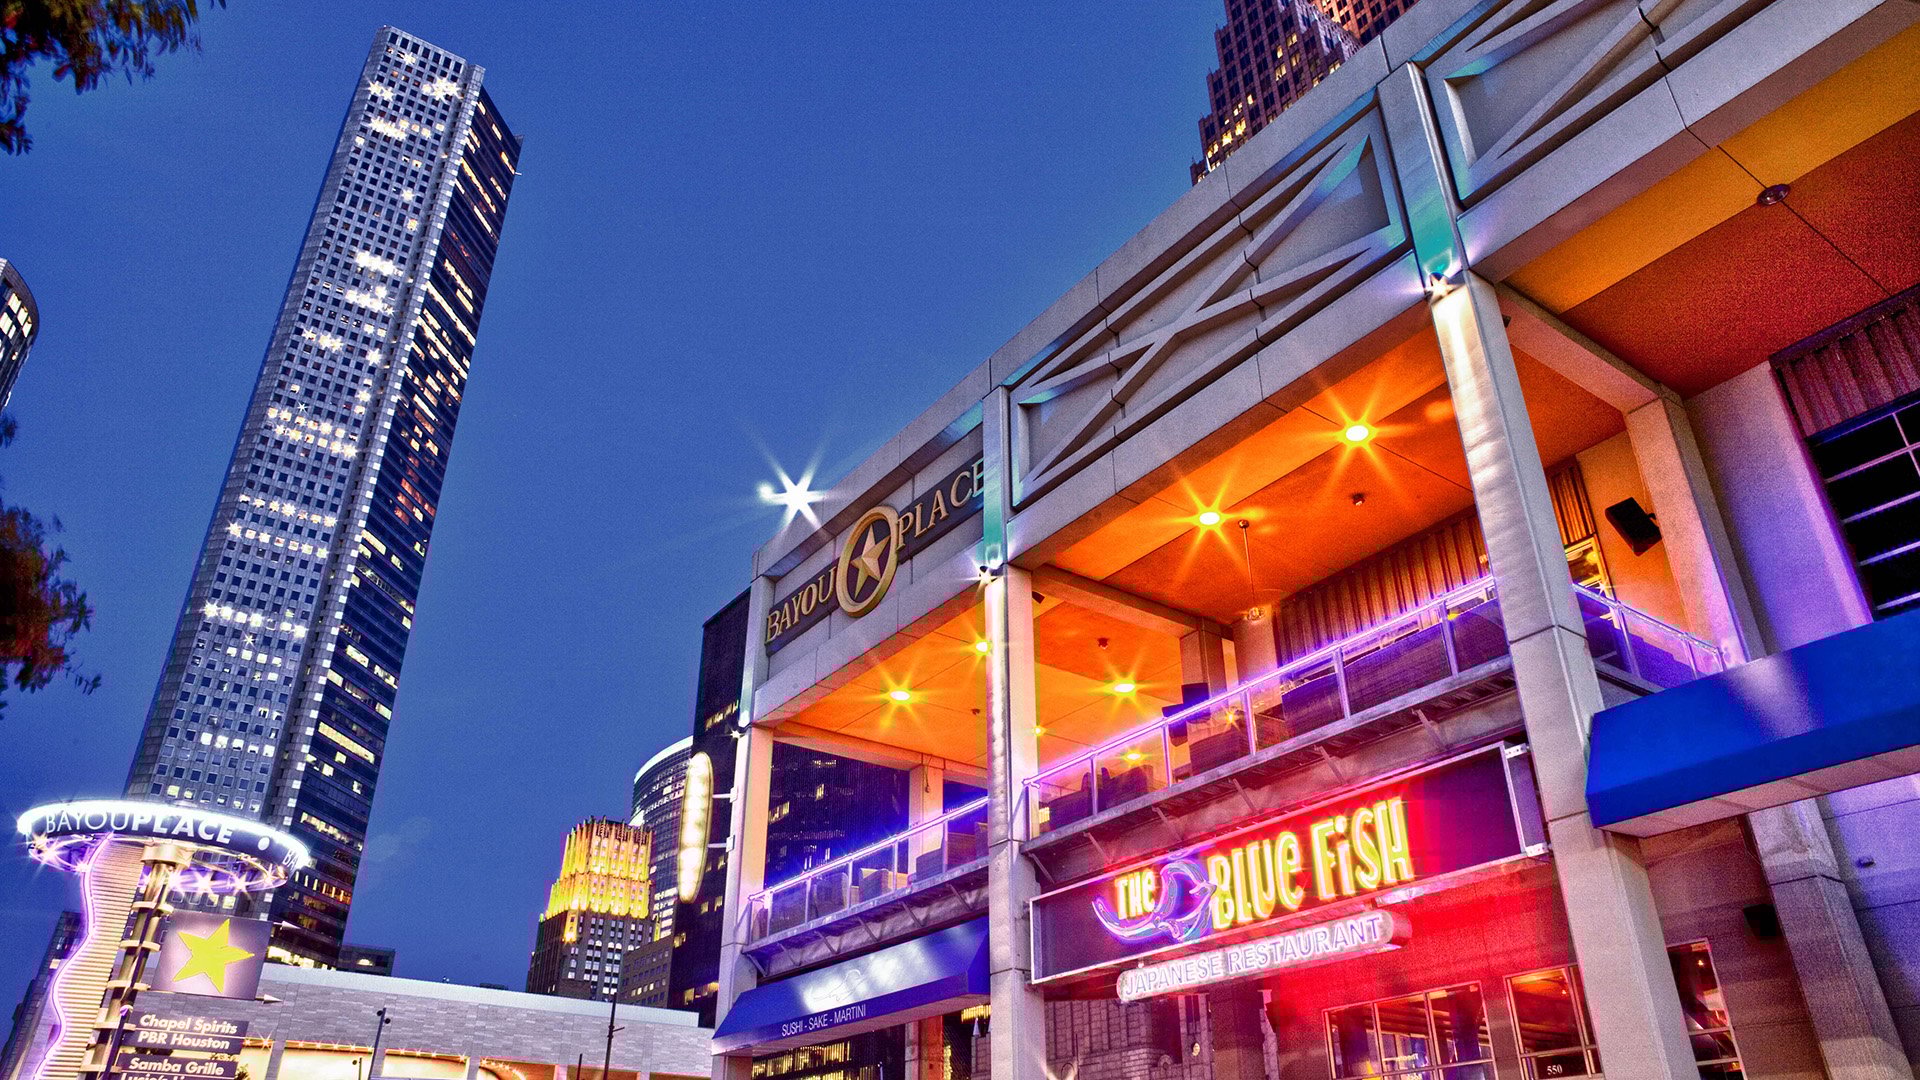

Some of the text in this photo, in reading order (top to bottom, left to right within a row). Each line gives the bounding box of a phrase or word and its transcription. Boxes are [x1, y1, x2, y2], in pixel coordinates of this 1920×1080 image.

[766, 458, 983, 643] BAYOU PLACE
[1125, 916, 1383, 996] JAPANESE RESTAURANT
[140, 1014, 238, 1034] Chapel Spirits
[782, 1020, 803, 1036] SUSHI
[808, 1014, 828, 1030] SAKE
[833, 1004, 866, 1024] MARTINI
[137, 1031, 230, 1049] PBR Houston
[129, 1057, 224, 1075] Samba Grille
[1546, 1064, 1563, 1075] 550
